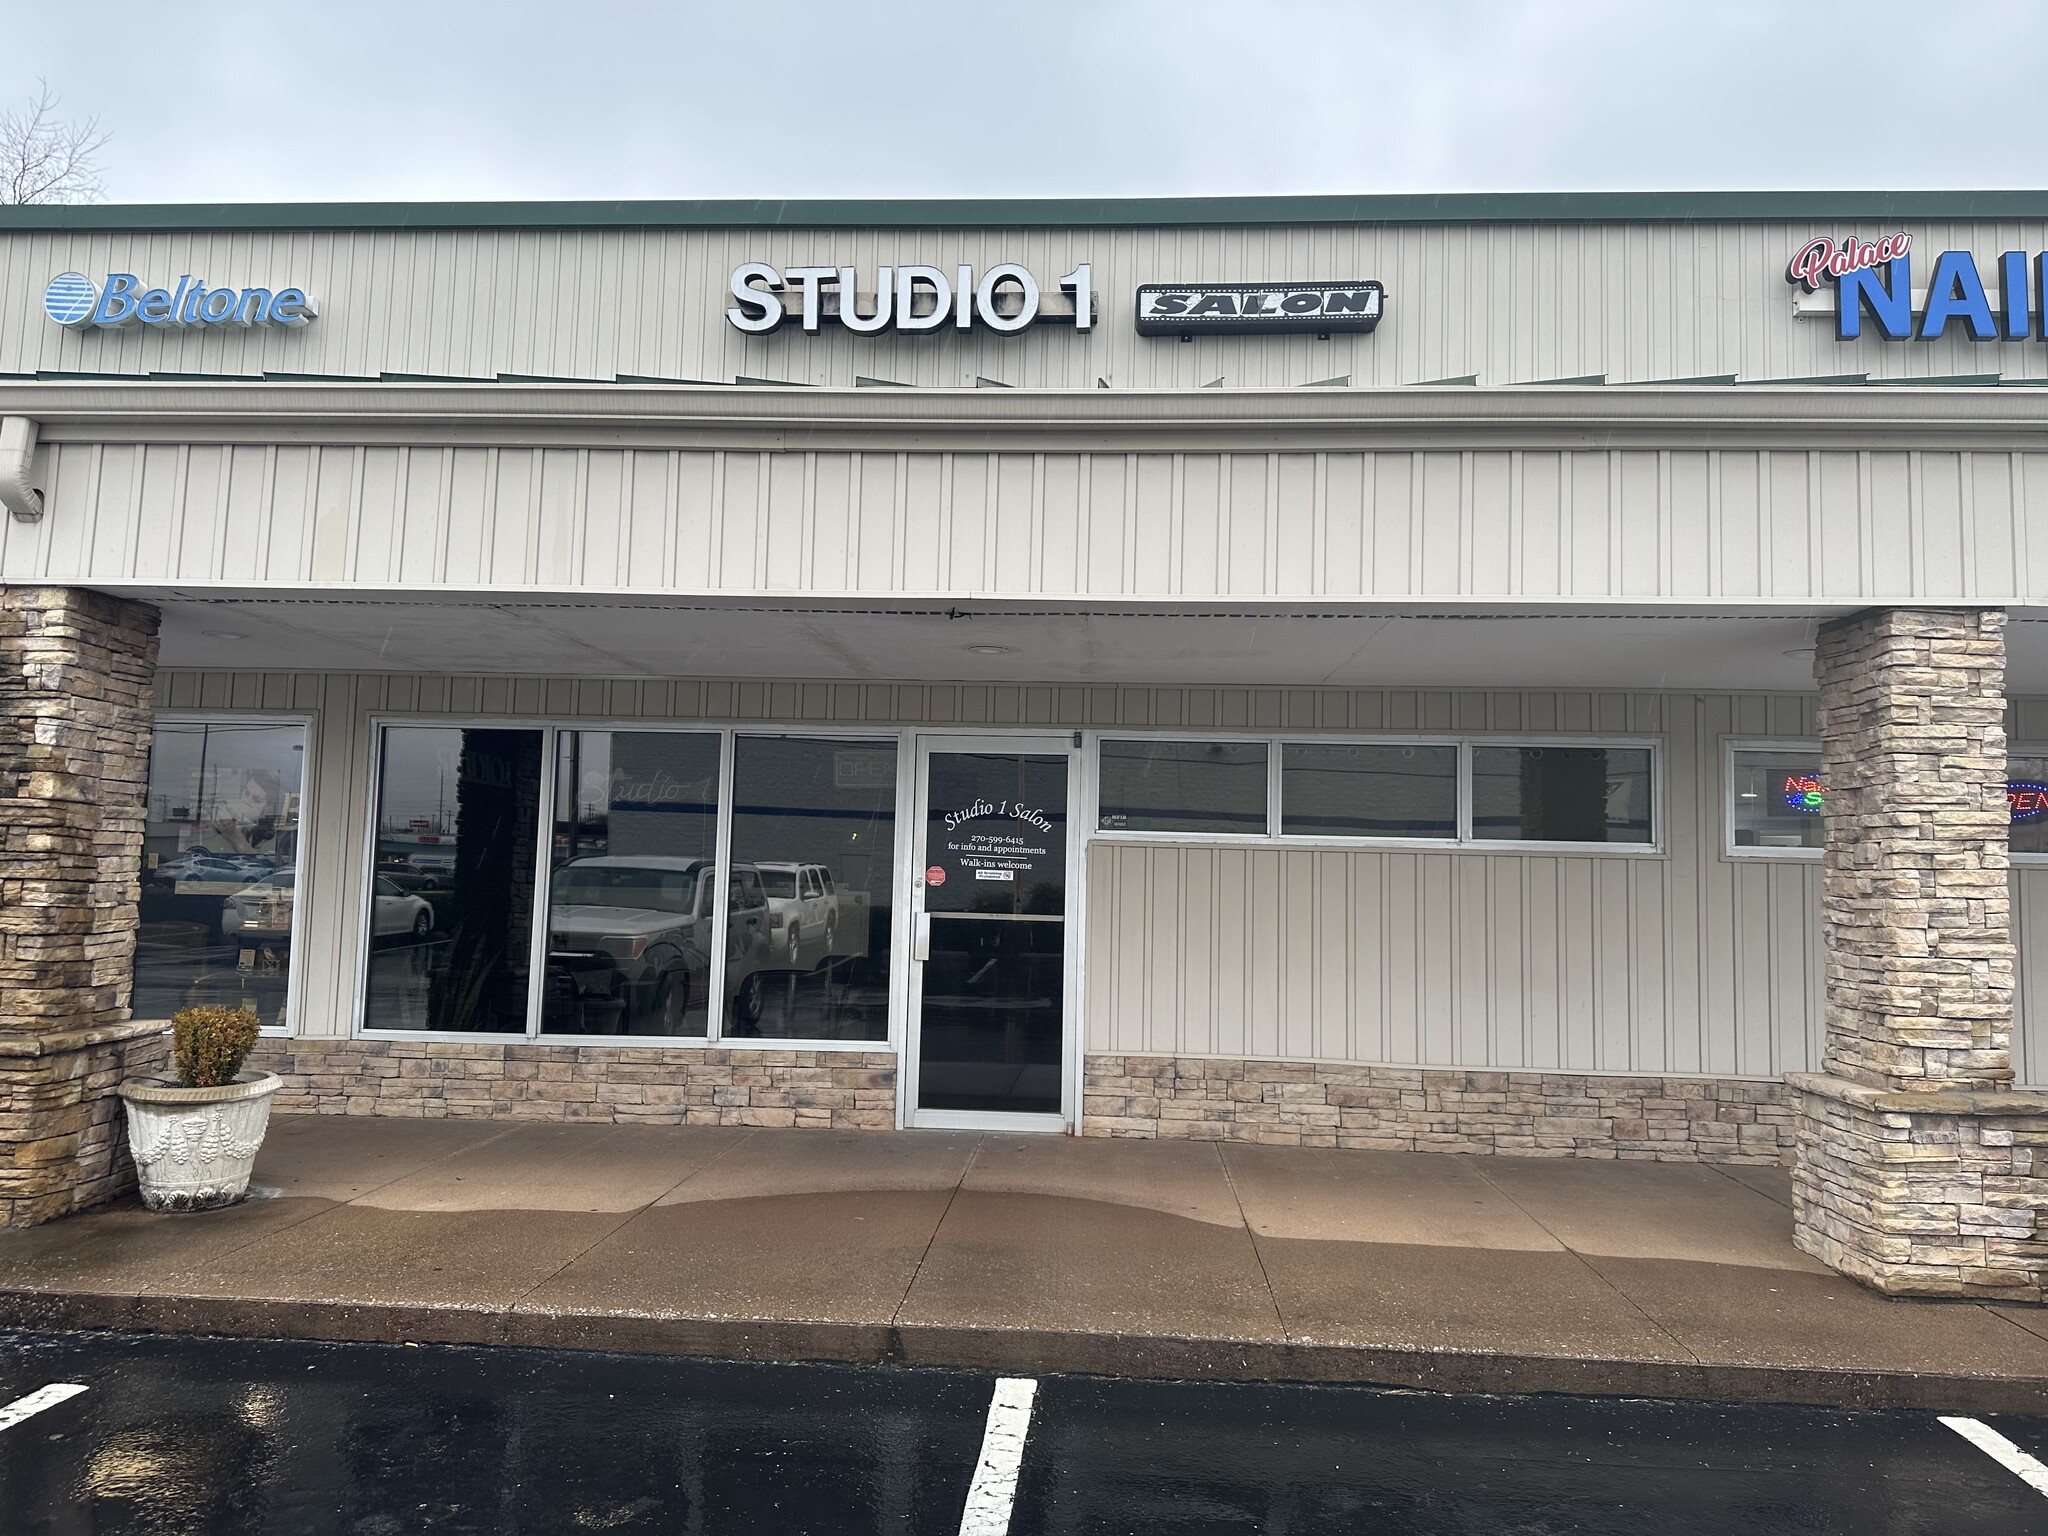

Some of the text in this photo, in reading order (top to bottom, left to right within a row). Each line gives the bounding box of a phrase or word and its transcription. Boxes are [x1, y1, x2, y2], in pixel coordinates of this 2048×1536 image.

[1787, 232, 1912, 291] Palace
[92, 272, 308, 326] Beltone
[727, 262, 1092, 333] STUDIO 1
[1148, 290, 1375, 318] SALON
[1836, 250, 2048, 340] NAI
[945, 798, 1053, 833] Studio 1 Salon
[947, 842, 1046, 855] for info and appointments
[971, 834, 1024, 845] 270-599-6415
[960, 858, 1032, 870] Walk-ins welcome
